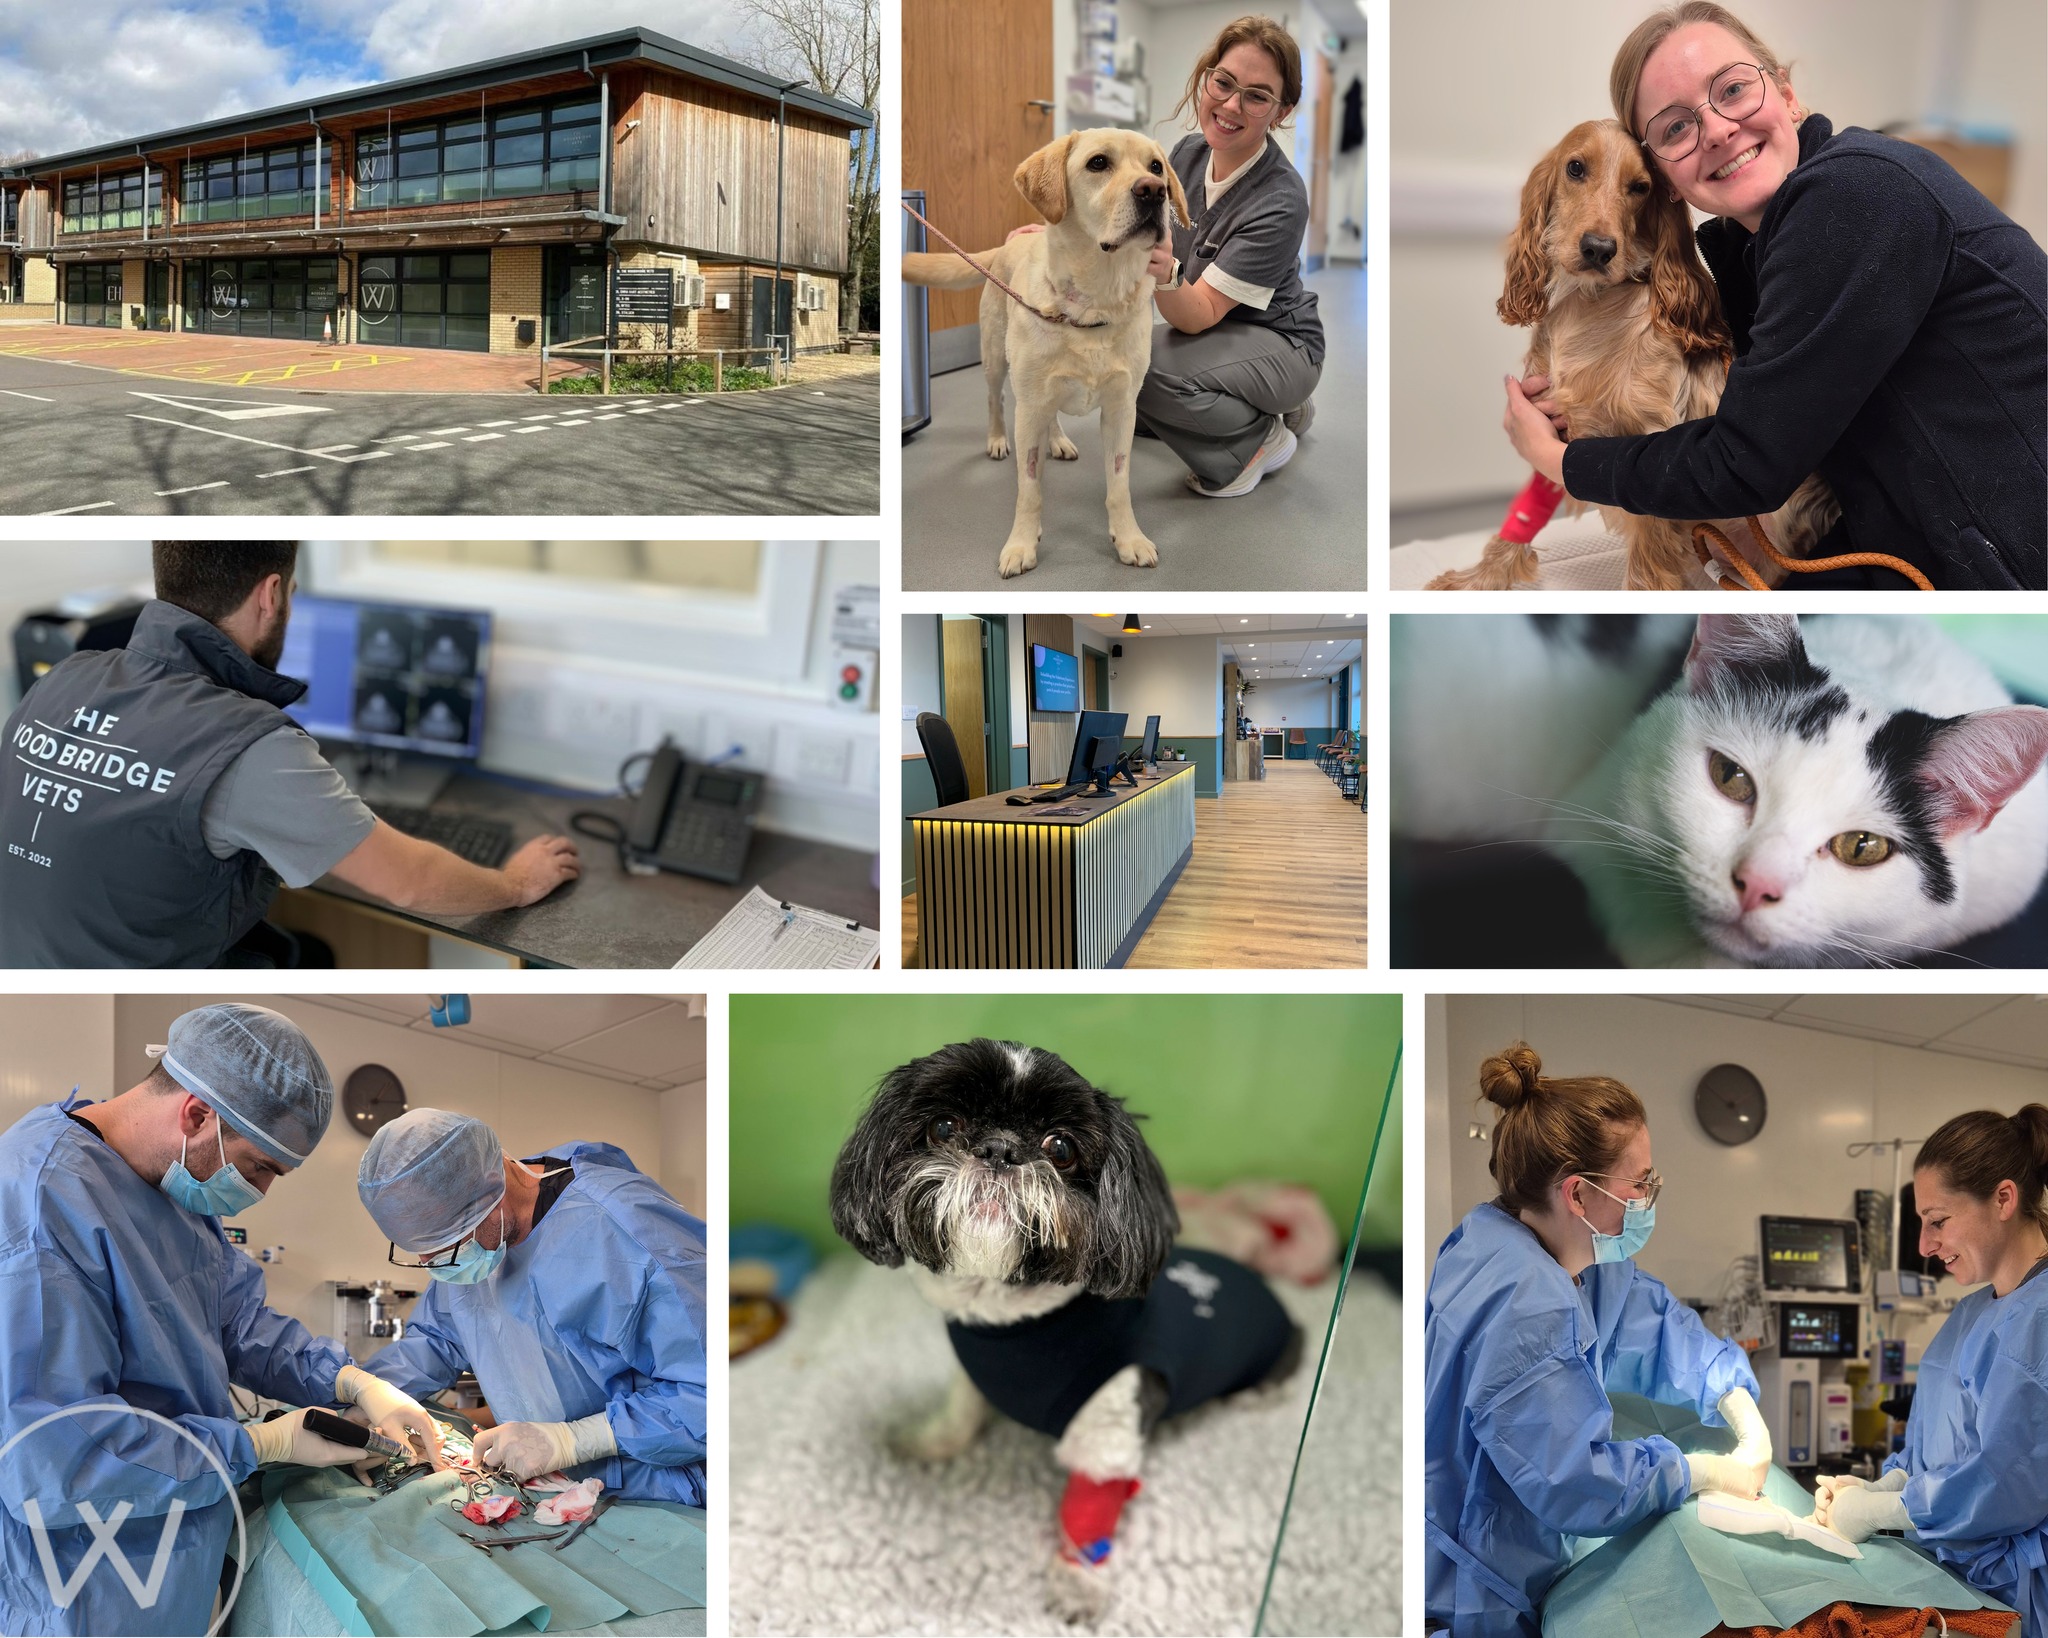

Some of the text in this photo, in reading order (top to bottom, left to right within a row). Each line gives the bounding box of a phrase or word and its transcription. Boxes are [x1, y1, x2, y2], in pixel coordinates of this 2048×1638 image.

[107, 285, 122, 301] EH
[361, 286, 386, 309] W
[22, 773, 83, 813] VETS
[8, 844, 52, 868] EST. 2022
